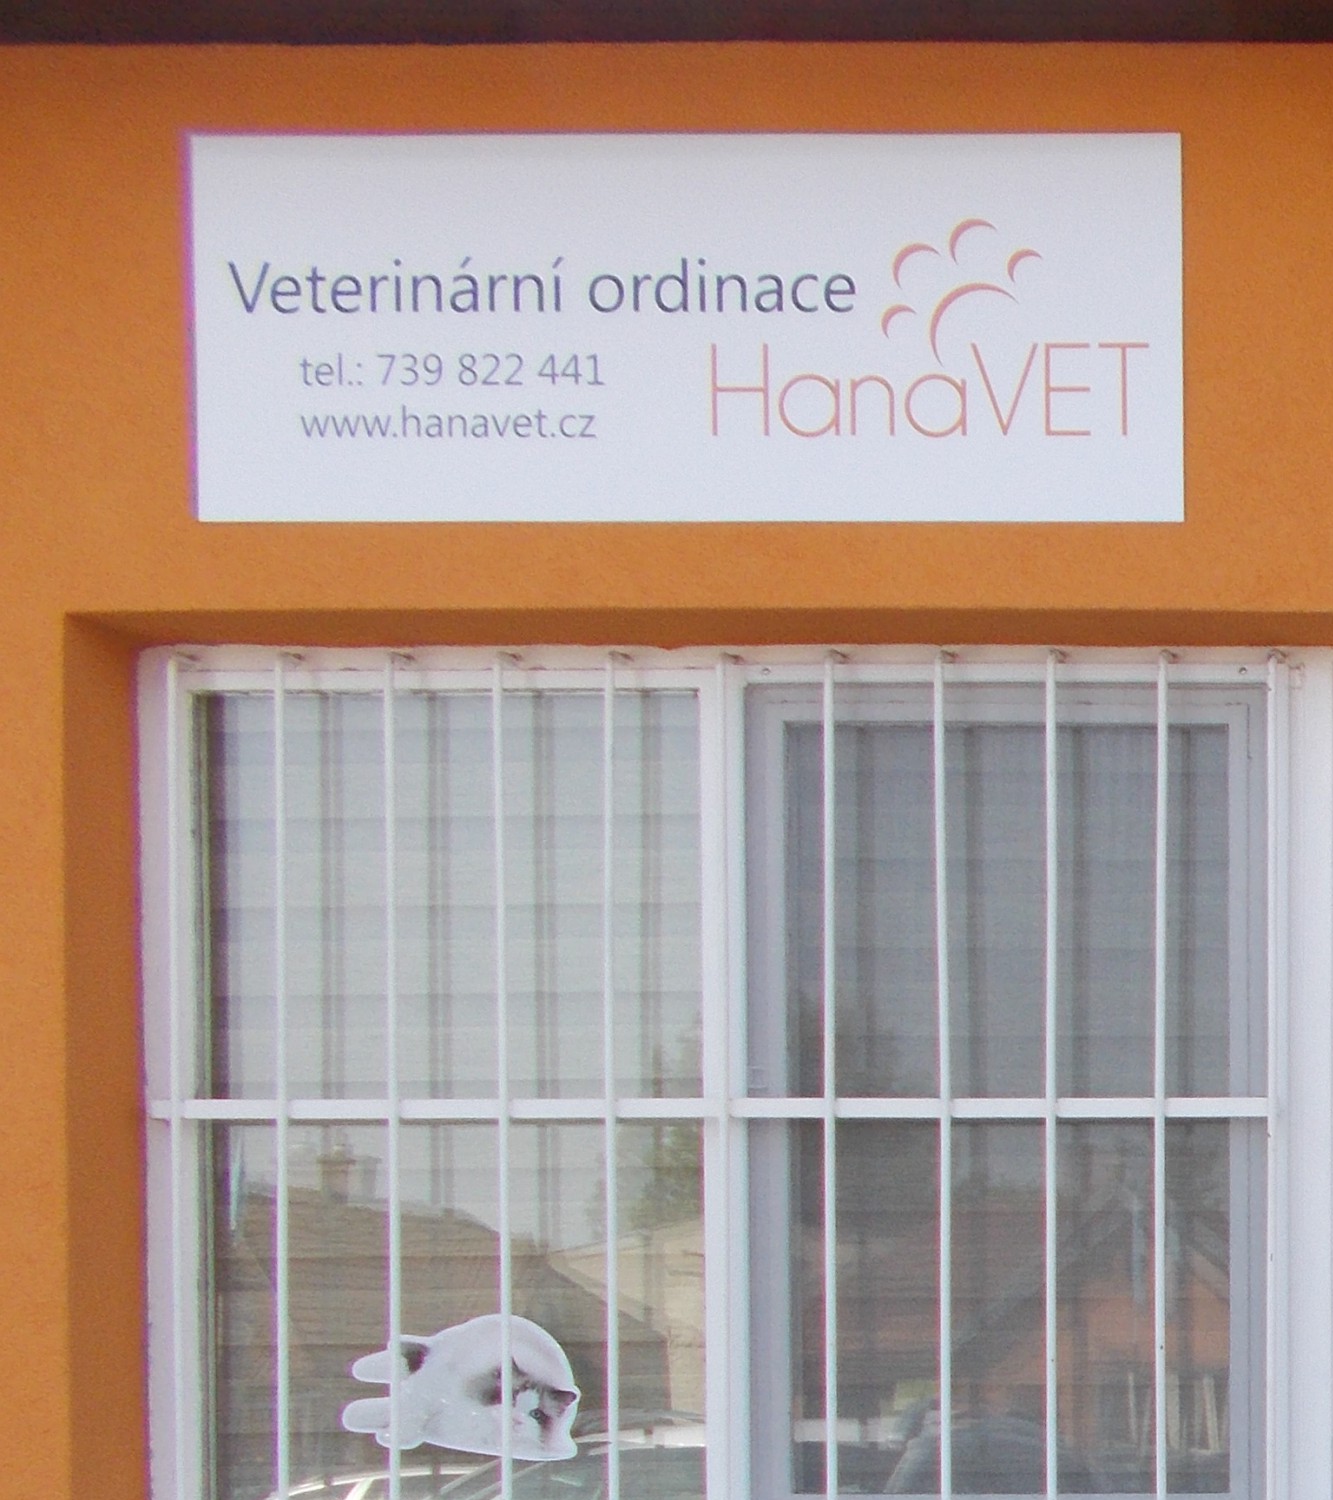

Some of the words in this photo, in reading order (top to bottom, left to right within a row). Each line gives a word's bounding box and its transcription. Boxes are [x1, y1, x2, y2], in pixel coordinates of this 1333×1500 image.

[228, 256, 565, 314] Veterinární
[588, 257, 857, 314] ordinace
[300, 353, 363, 387] tel.:
[377, 353, 443, 387] 739
[458, 353, 524, 387] 822
[537, 353, 605, 387] 441
[710, 342, 1150, 437] HanaVET
[300, 405, 596, 439] www.hanavet.cz
